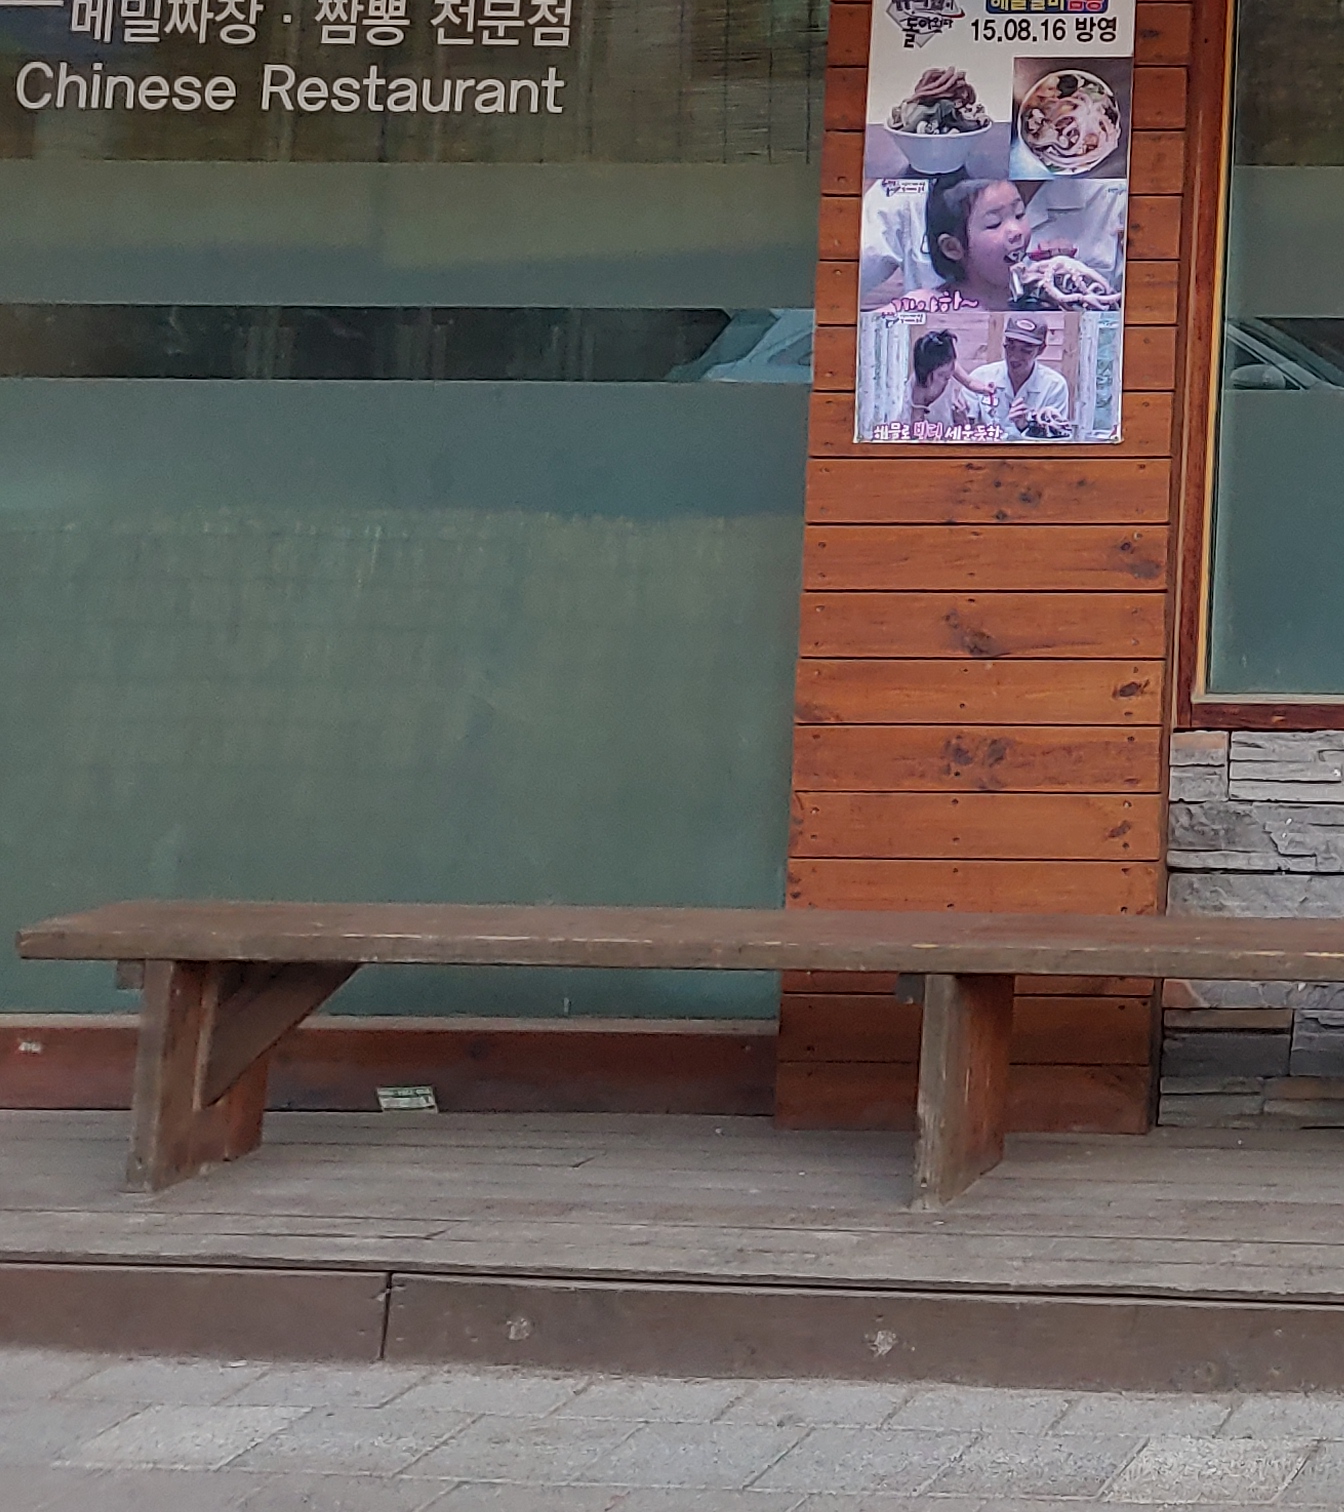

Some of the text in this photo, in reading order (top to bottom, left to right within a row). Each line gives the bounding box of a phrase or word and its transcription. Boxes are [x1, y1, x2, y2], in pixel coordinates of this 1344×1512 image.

[970, 16, 1118, 43] 15.08.16 방영
[14, 61, 565, 114] Chinese Restaurant
